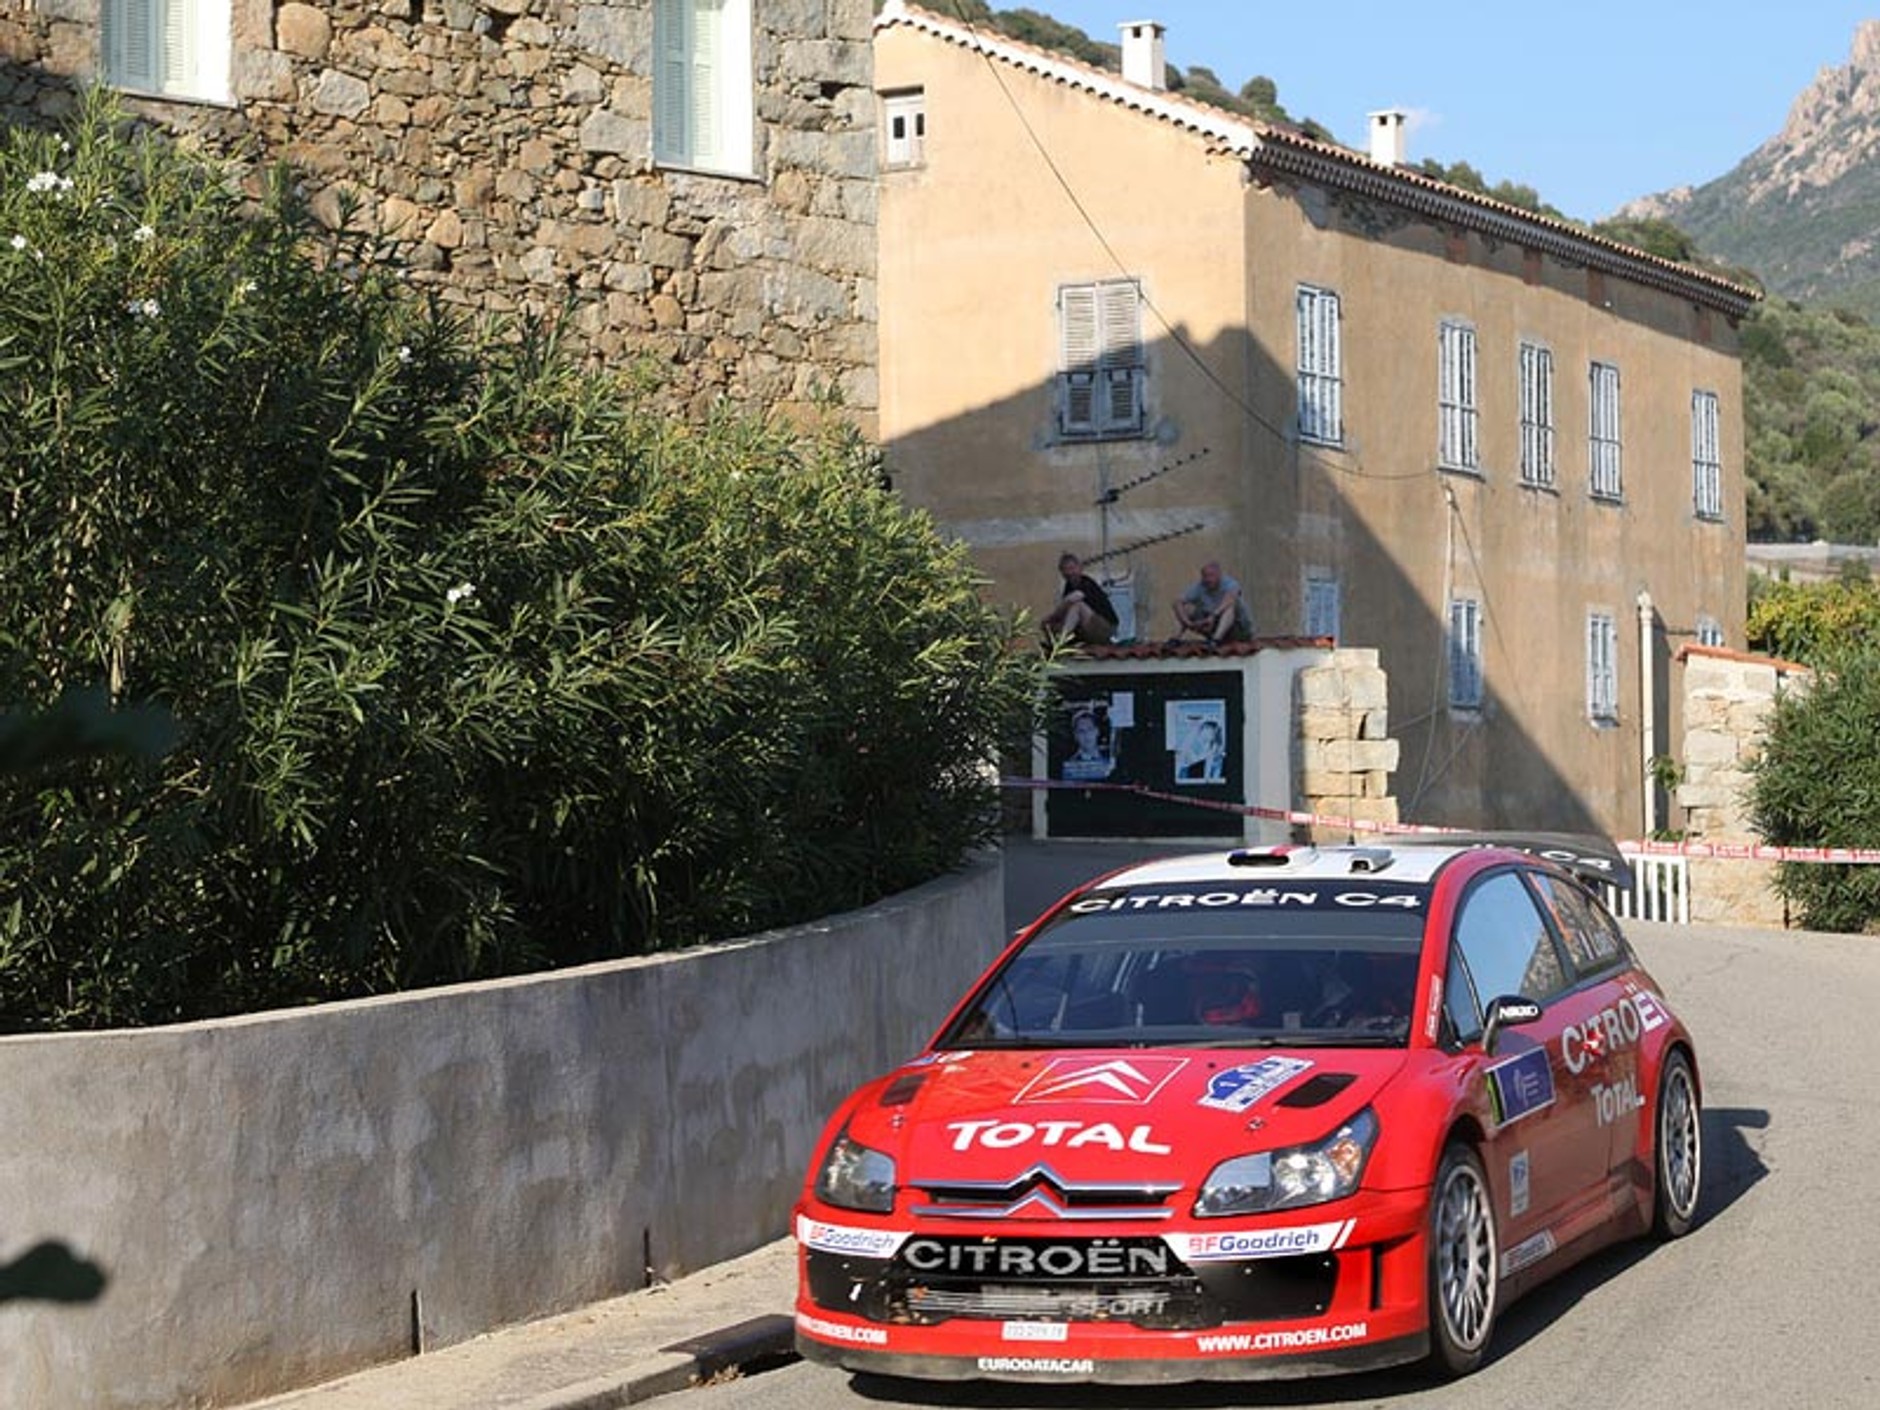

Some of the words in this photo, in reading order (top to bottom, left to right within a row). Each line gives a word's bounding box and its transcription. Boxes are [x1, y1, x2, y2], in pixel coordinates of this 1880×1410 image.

[1070, 888, 1317, 913] CITROËN
[1334, 893, 1422, 908] C4
[1590, 1072, 1646, 1127] TOTAL
[947, 1119, 1173, 1155] TOTAL
[809, 1224, 895, 1249] BFGoodrich
[1189, 1229, 1320, 1251] BFGoodrich
[904, 1238, 1168, 1275] CITROËN
[1197, 1323, 1368, 1351] WWW.CITROEN.COM
